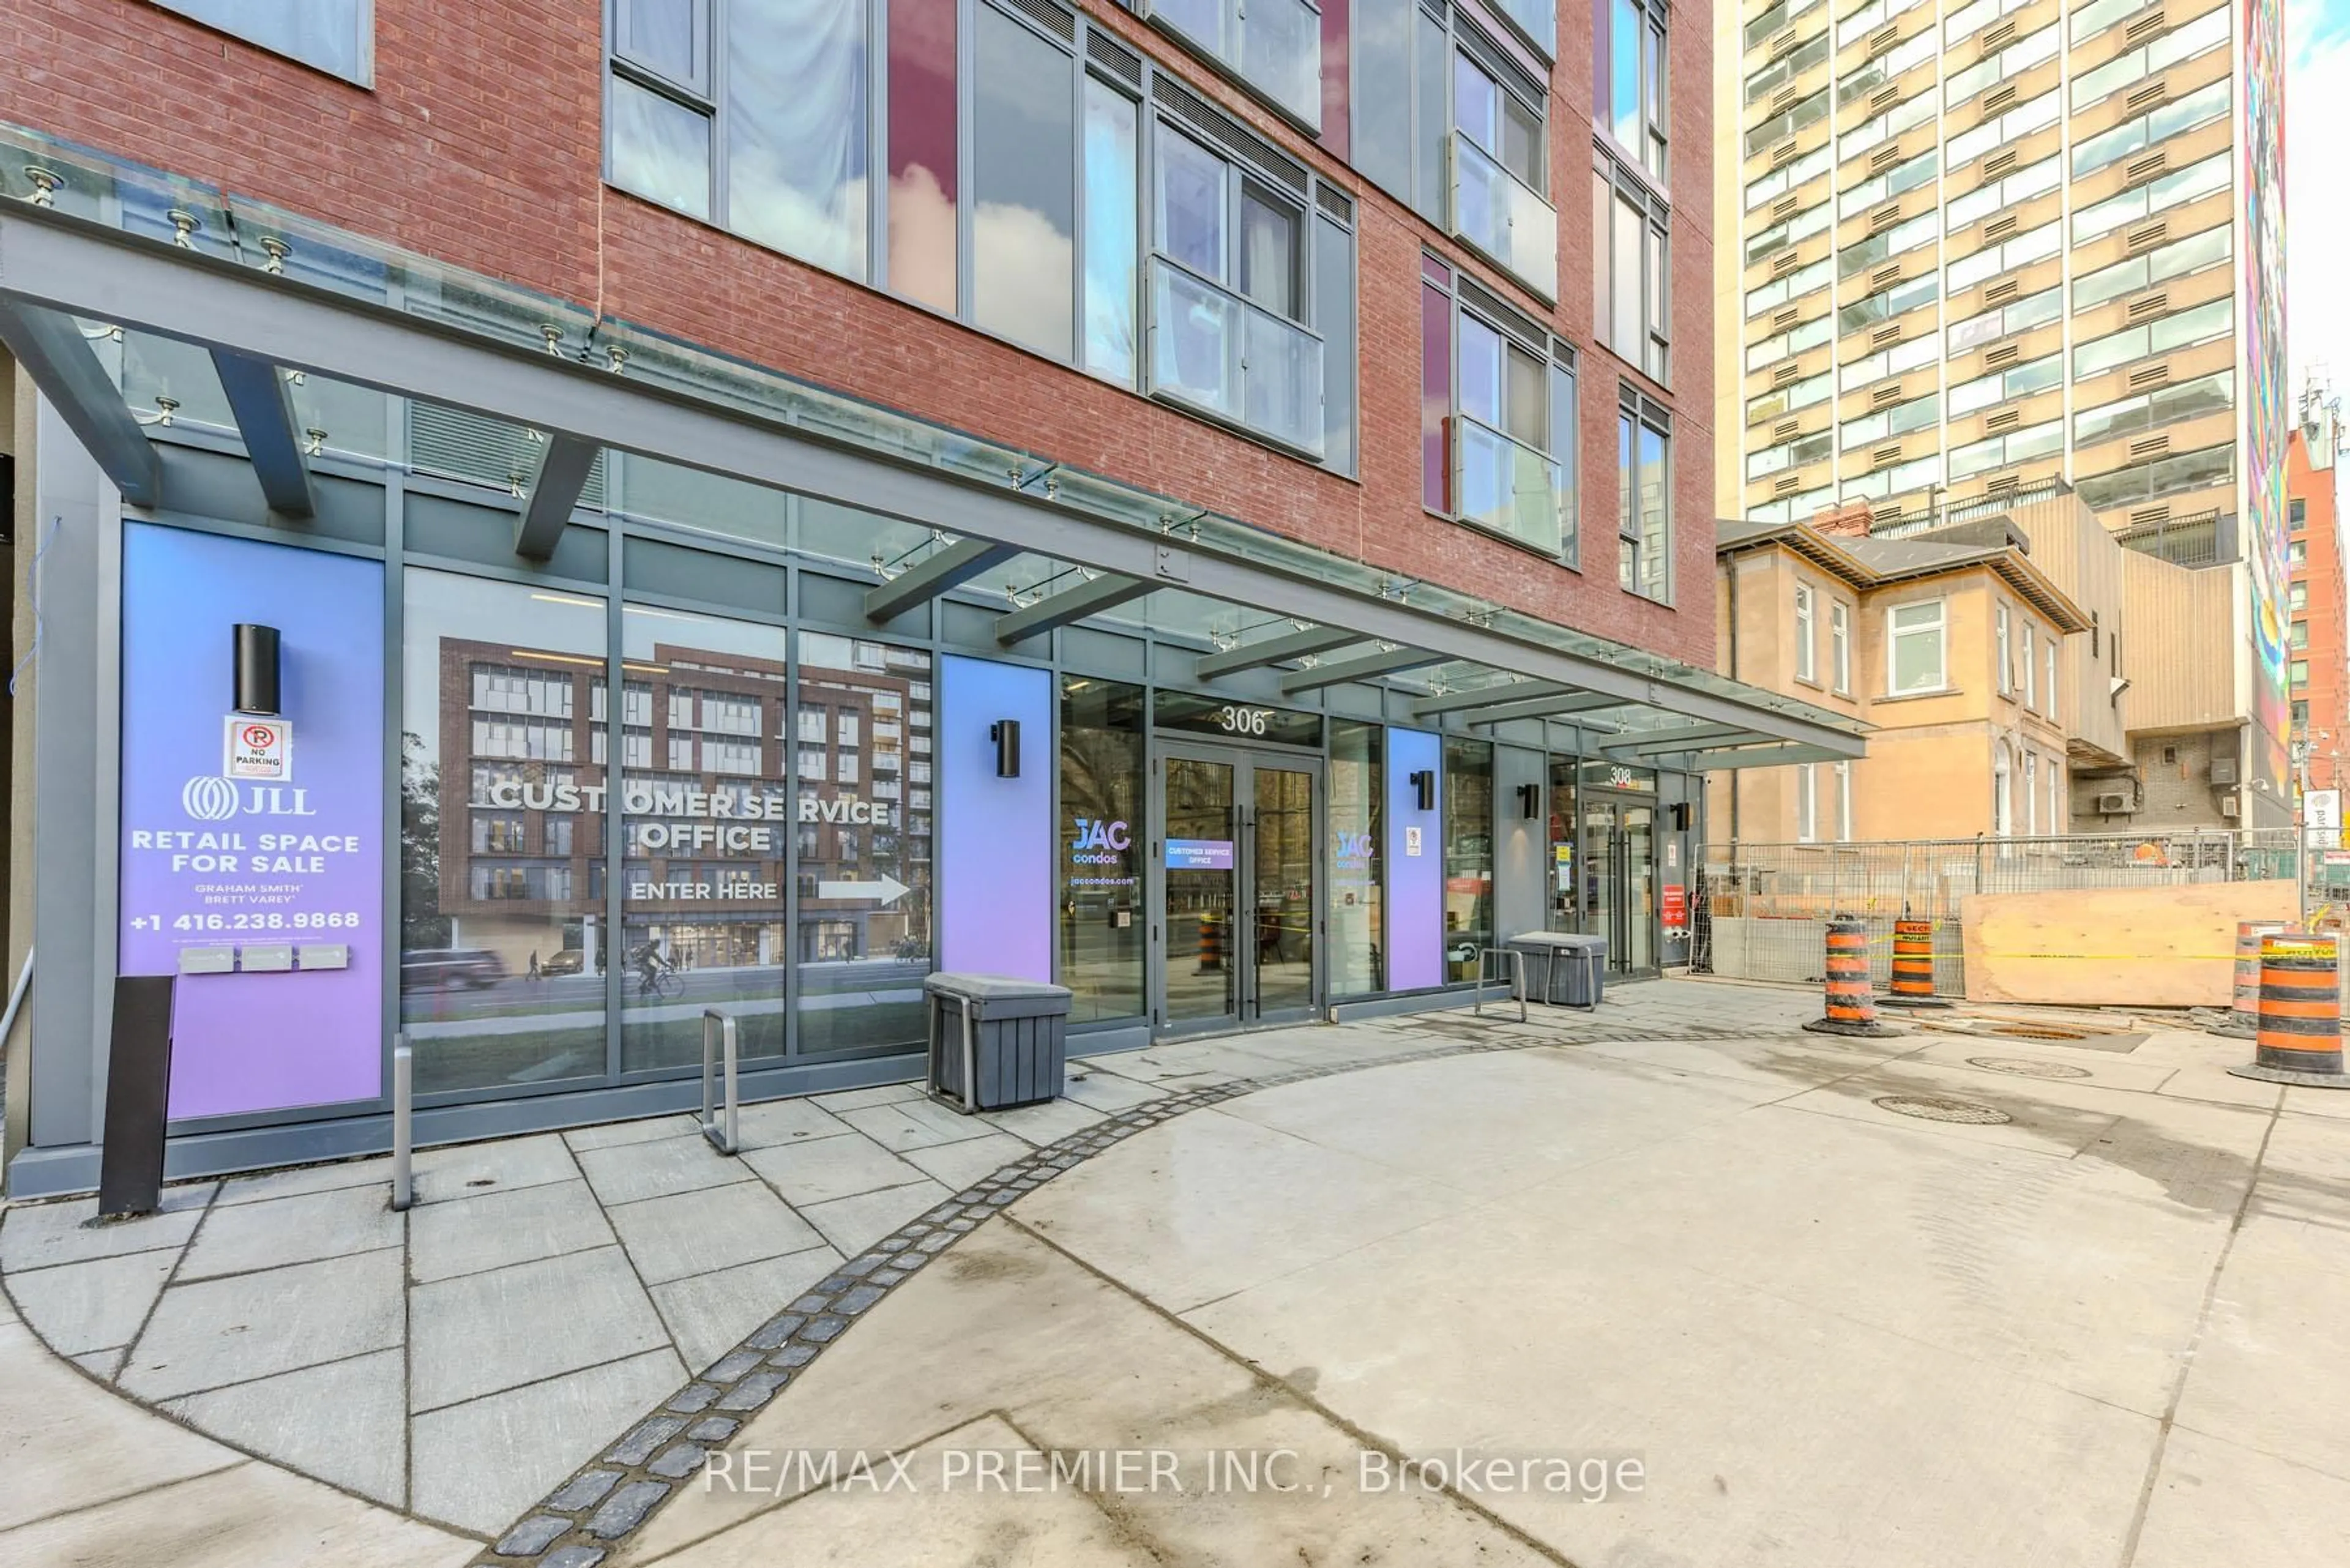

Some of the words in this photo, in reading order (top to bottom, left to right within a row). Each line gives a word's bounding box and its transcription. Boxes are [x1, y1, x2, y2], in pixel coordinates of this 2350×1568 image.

[1222, 706, 1266, 734] 306
[236, 756, 280, 766] PARKING
[1610, 766, 1631, 784] 308
[242, 786, 316, 815] JLL
[491, 781, 733, 818] CUSTOMER
[742, 796, 889, 826] SERVICE
[132, 831, 246, 851] RETAIL
[259, 834, 360, 853] SPACE
[640, 823, 771, 850] OFFICE
[1073, 818, 1131, 850] JAC
[172, 854, 237, 872] FOR
[251, 856, 325, 873] SALE
[1073, 851, 1117, 864] condos
[195, 884, 256, 893] GRAHAM
[1070, 876, 1134, 886] jaccondos.com
[205, 895, 245, 904] BRETT
[632, 882, 711, 900] ENTER
[718, 883, 778, 900] HERE
[130, 914, 160, 930] +1
[173, 912, 360, 930] 416.238.9868
